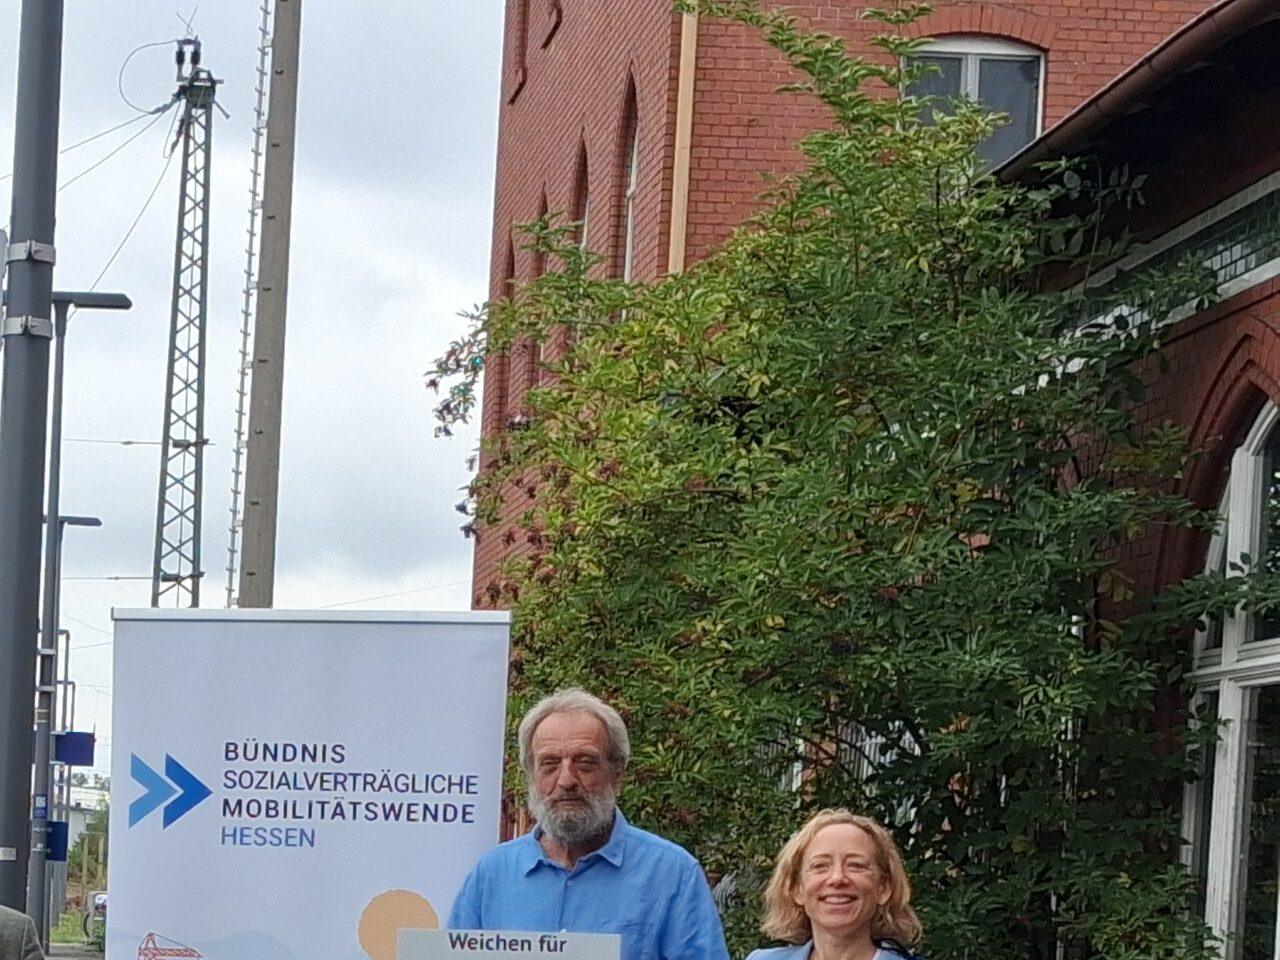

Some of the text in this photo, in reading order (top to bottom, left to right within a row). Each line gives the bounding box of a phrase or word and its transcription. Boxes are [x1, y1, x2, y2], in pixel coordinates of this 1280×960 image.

[223, 739, 346, 764] BÜNDNIS
[223, 768, 479, 796] SOZIALVERTRÄGLICHE
[222, 796, 475, 824] MOBILITÄTSWENDE
[220, 826, 316, 849] HESSEN
[448, 931, 567, 953] Weichen für
